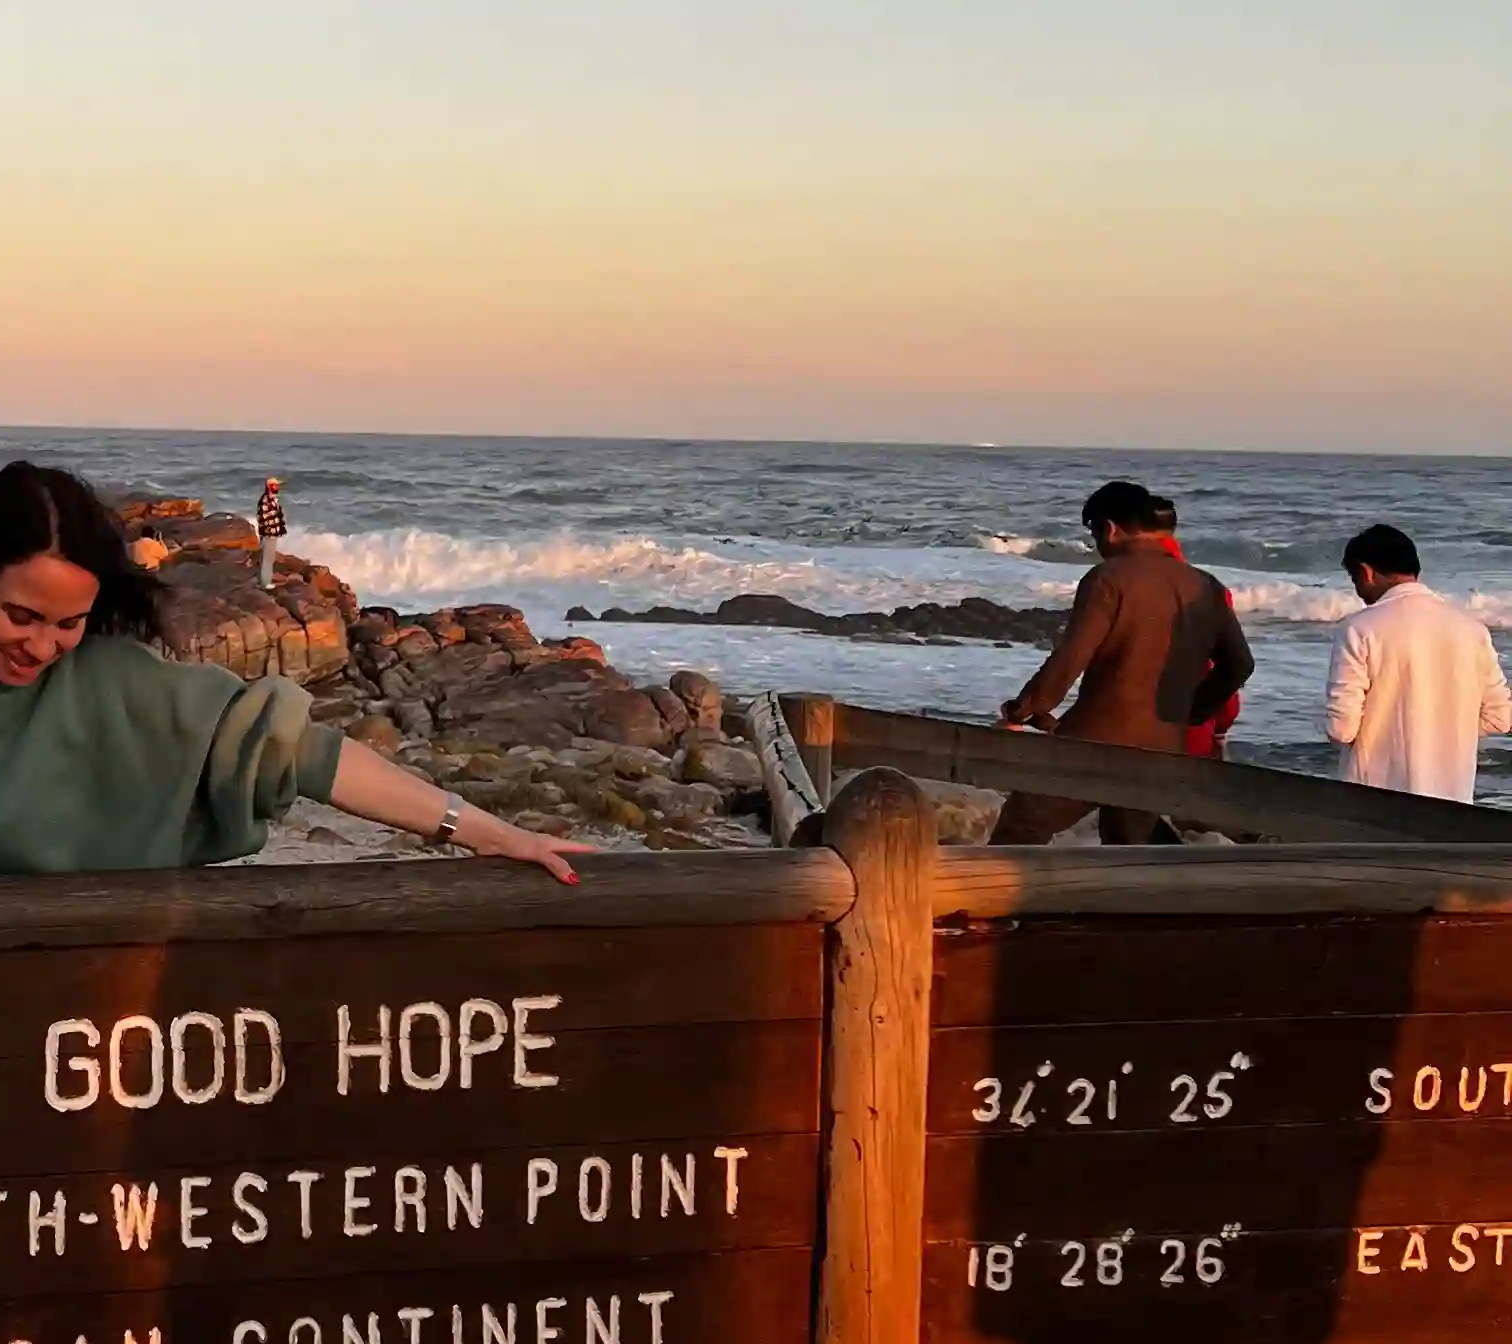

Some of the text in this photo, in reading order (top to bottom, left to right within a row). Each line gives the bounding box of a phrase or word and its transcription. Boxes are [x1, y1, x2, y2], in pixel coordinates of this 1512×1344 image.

[44, 1007, 286, 1113] GOOD
[336, 994, 563, 1096] HOPE
[527, 1146, 749, 1226] POINT
[1357, 1223, 1512, 1275] EAST
